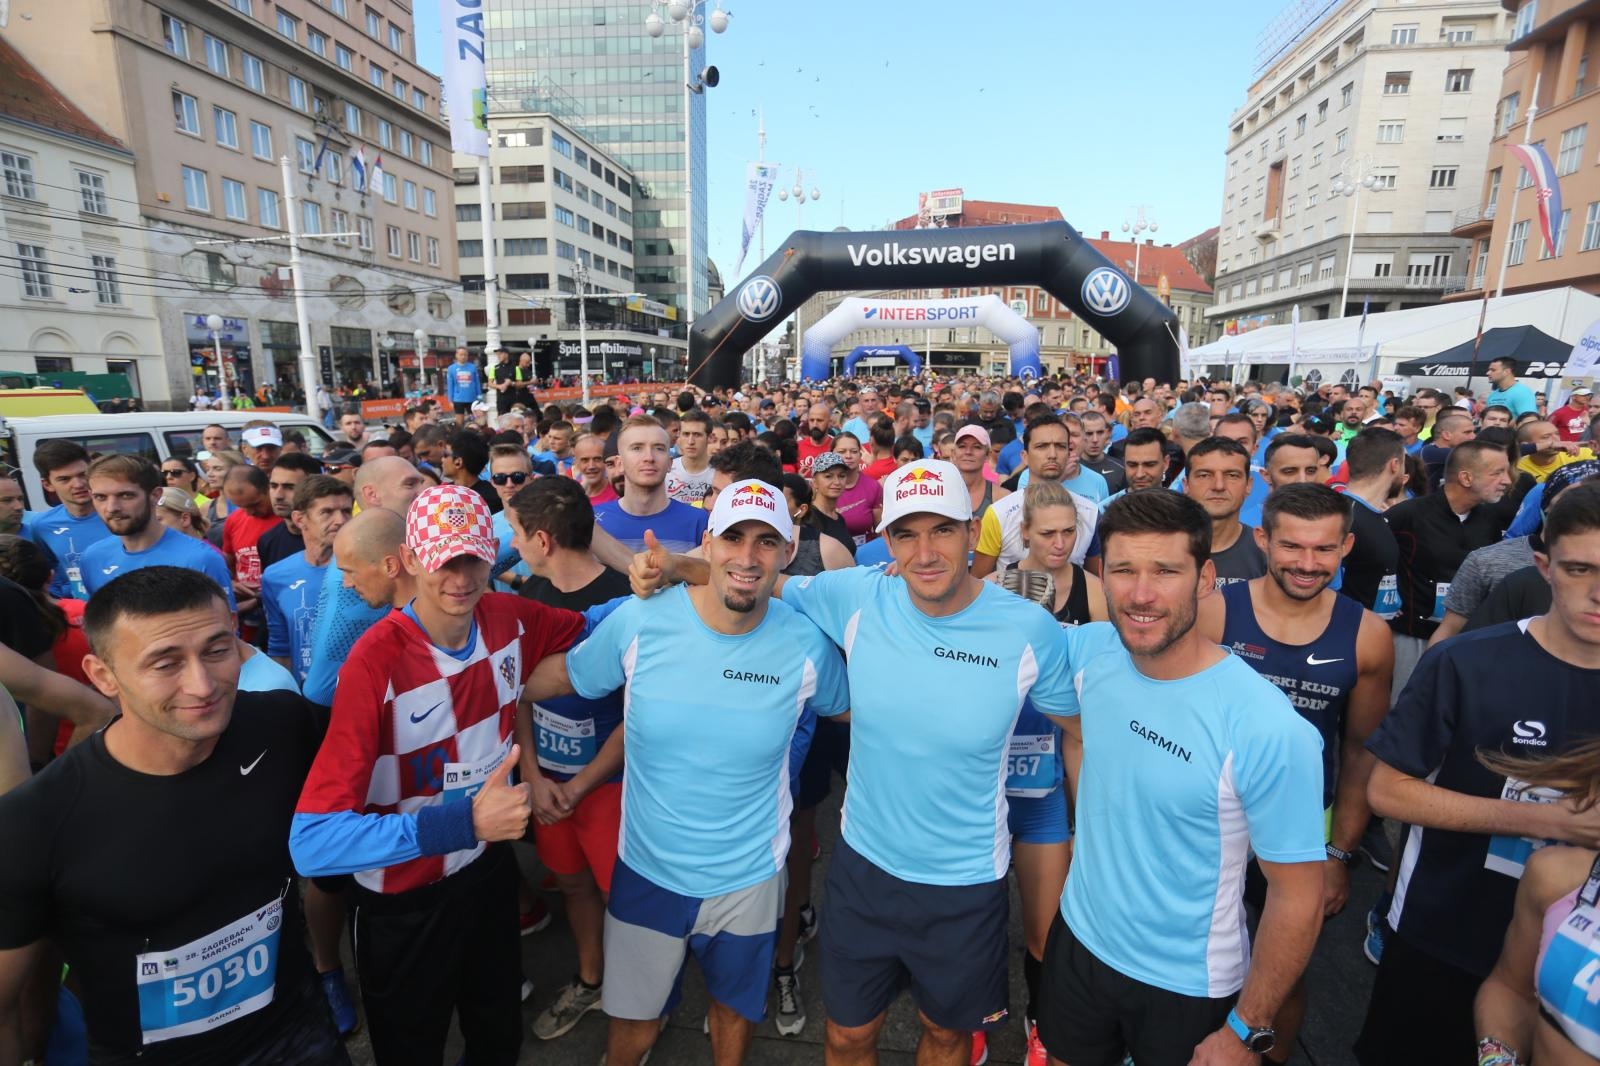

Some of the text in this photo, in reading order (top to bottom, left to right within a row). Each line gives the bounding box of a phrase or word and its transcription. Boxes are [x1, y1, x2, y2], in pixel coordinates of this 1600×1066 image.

[847, 242, 1016, 269] Volkswagen
[879, 306, 977, 321] INTERSPORT
[559, 342, 588, 356] Špic
[731, 496, 775, 512] Red Bull
[896, 484, 944, 501] Red Bull
[934, 646, 1000, 669] GARMIN
[723, 669, 781, 686] GARMIN
[1260, 673, 1341, 697] TSKI KLUB
[539, 728, 582, 756] 5145
[1129, 720, 1193, 764] GARMIN
[1512, 736, 1547, 747] Sondico
[185, 924, 254, 961] 28. ZAGREBAČKI
[201, 936, 244, 961] MARATON
[173, 944, 269, 1007] 5030
[207, 1005, 241, 1024] GARMIN
